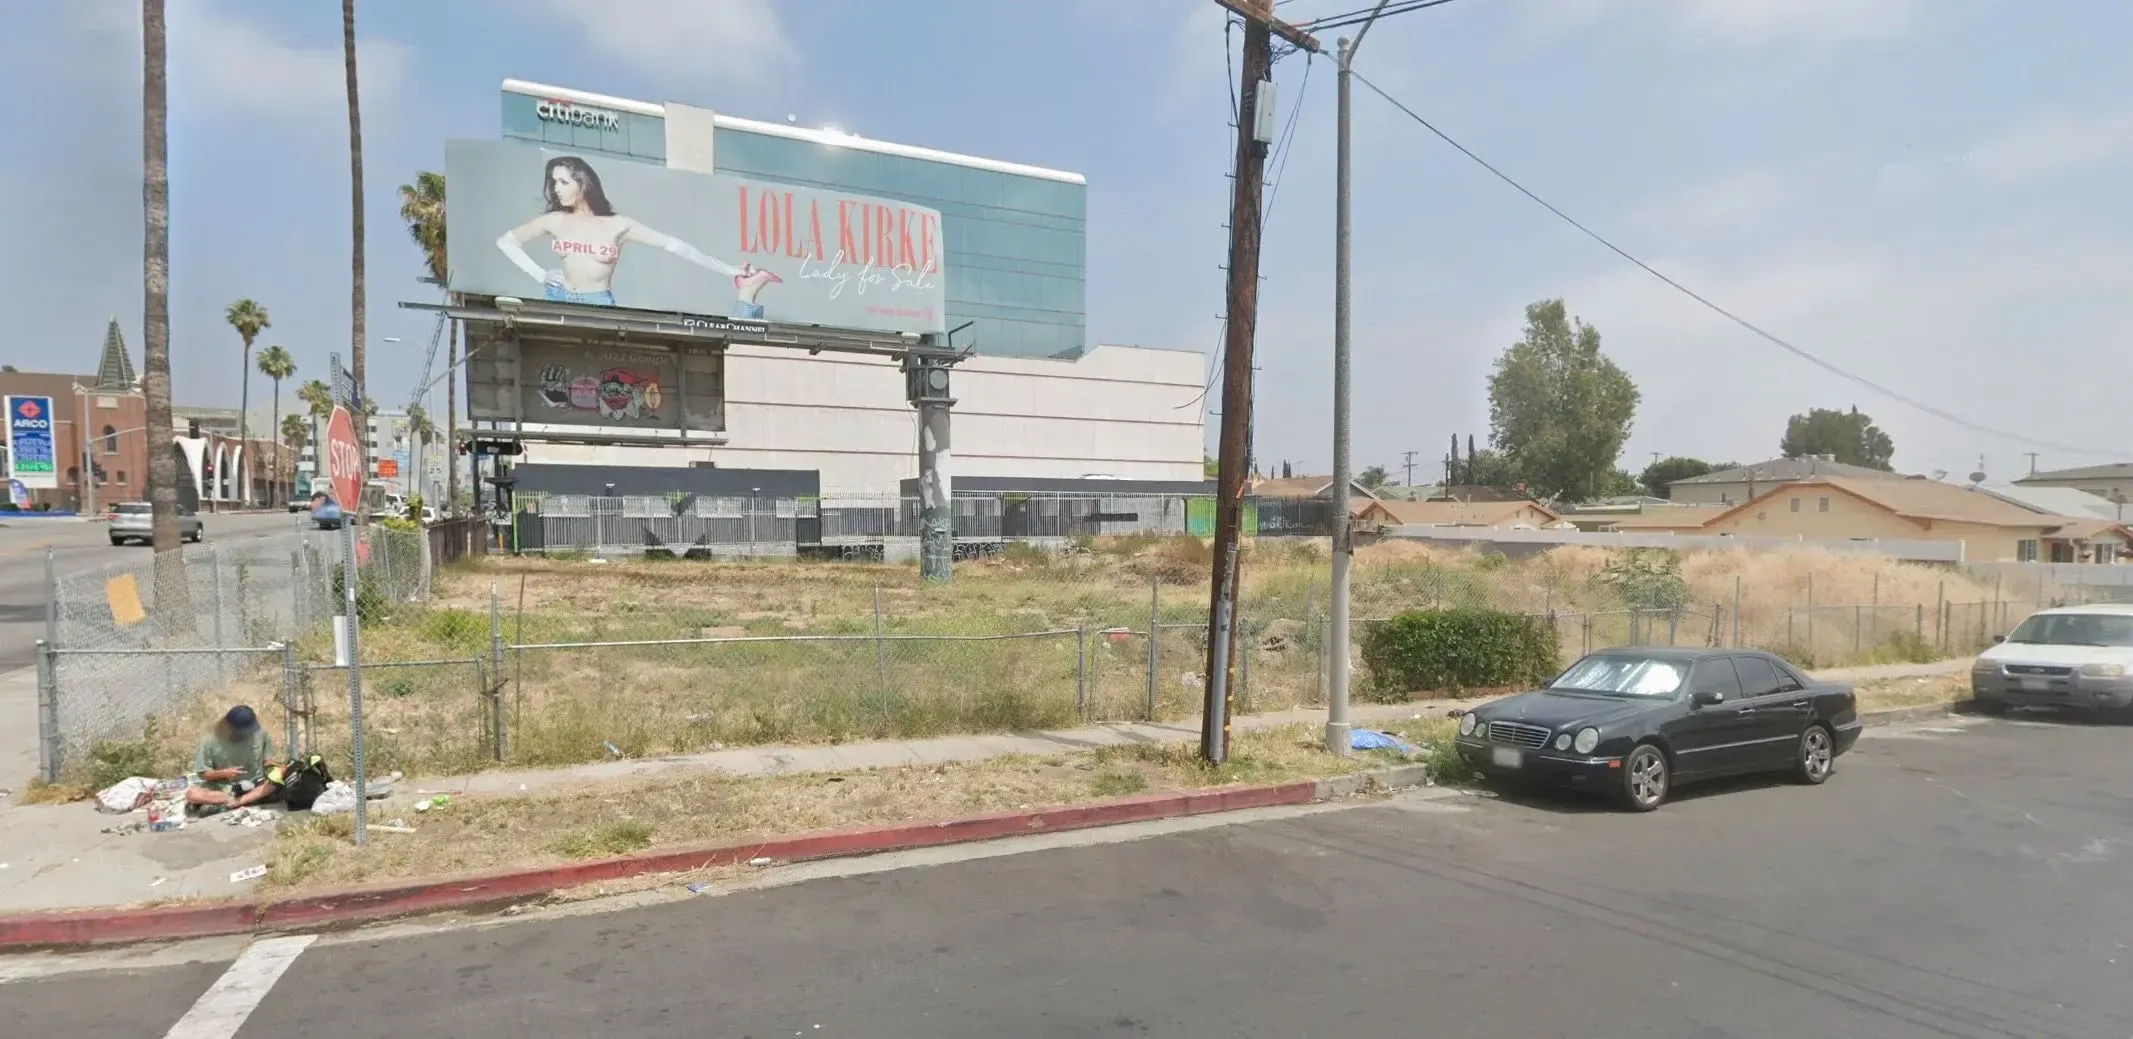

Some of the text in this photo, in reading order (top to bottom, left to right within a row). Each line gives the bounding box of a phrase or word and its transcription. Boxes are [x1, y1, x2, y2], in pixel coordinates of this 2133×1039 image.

[536, 98, 618, 129] citibank
[738, 186, 938, 274] LOLA KIRKE
[553, 241, 618, 257] APRIL 29
[799, 250, 937, 299] Lady for Sale
[14, 418, 47, 429] ARCO
[331, 438, 359, 480] STOP
